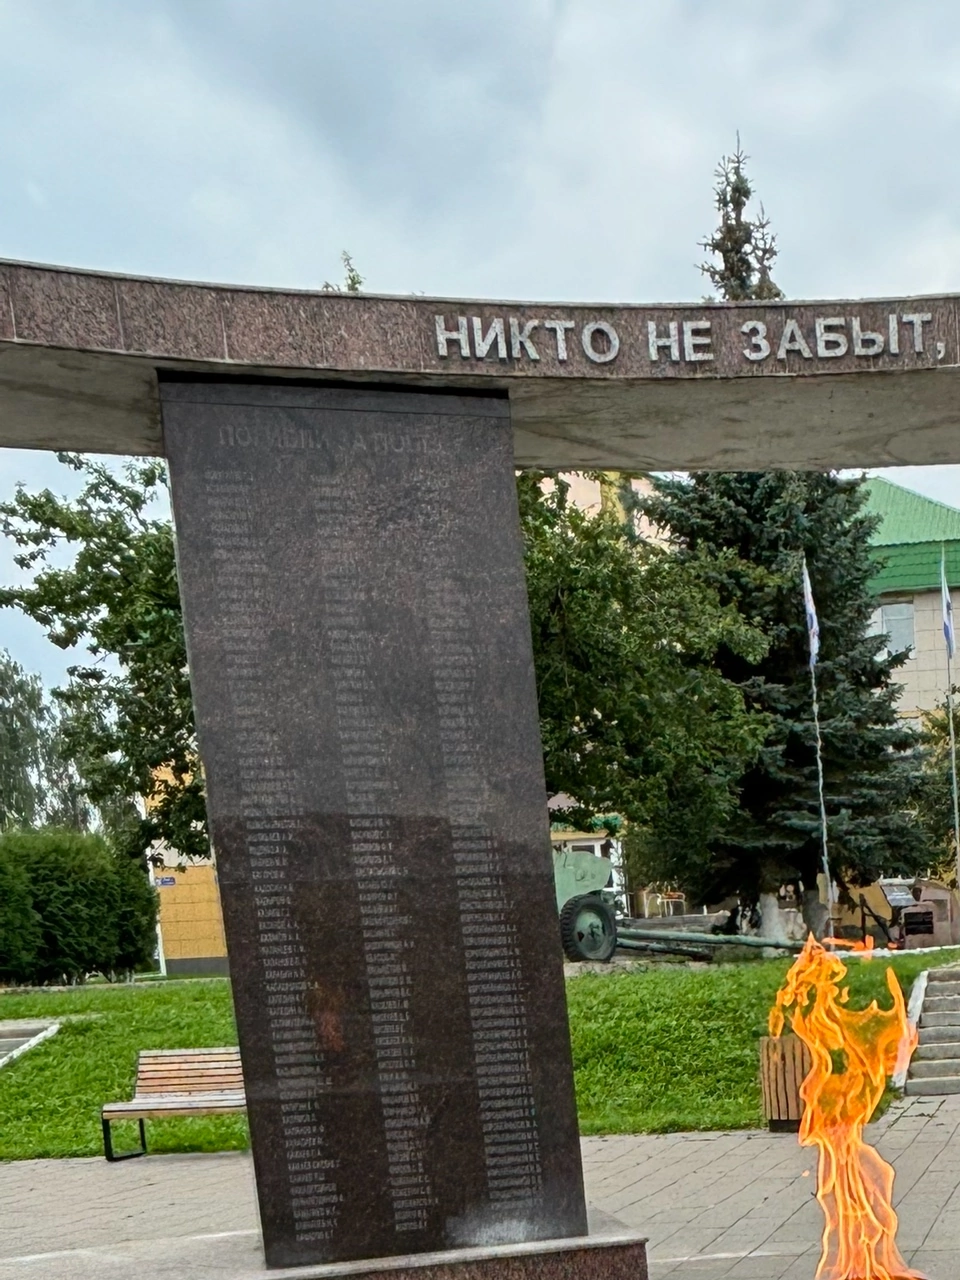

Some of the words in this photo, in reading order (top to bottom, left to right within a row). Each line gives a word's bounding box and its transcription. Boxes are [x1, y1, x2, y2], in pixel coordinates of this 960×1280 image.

[434, 314, 620, 364] НИКТО
[647, 320, 715, 362] НЕ
[740, 313, 945, 361] ЗАБЫТ,
